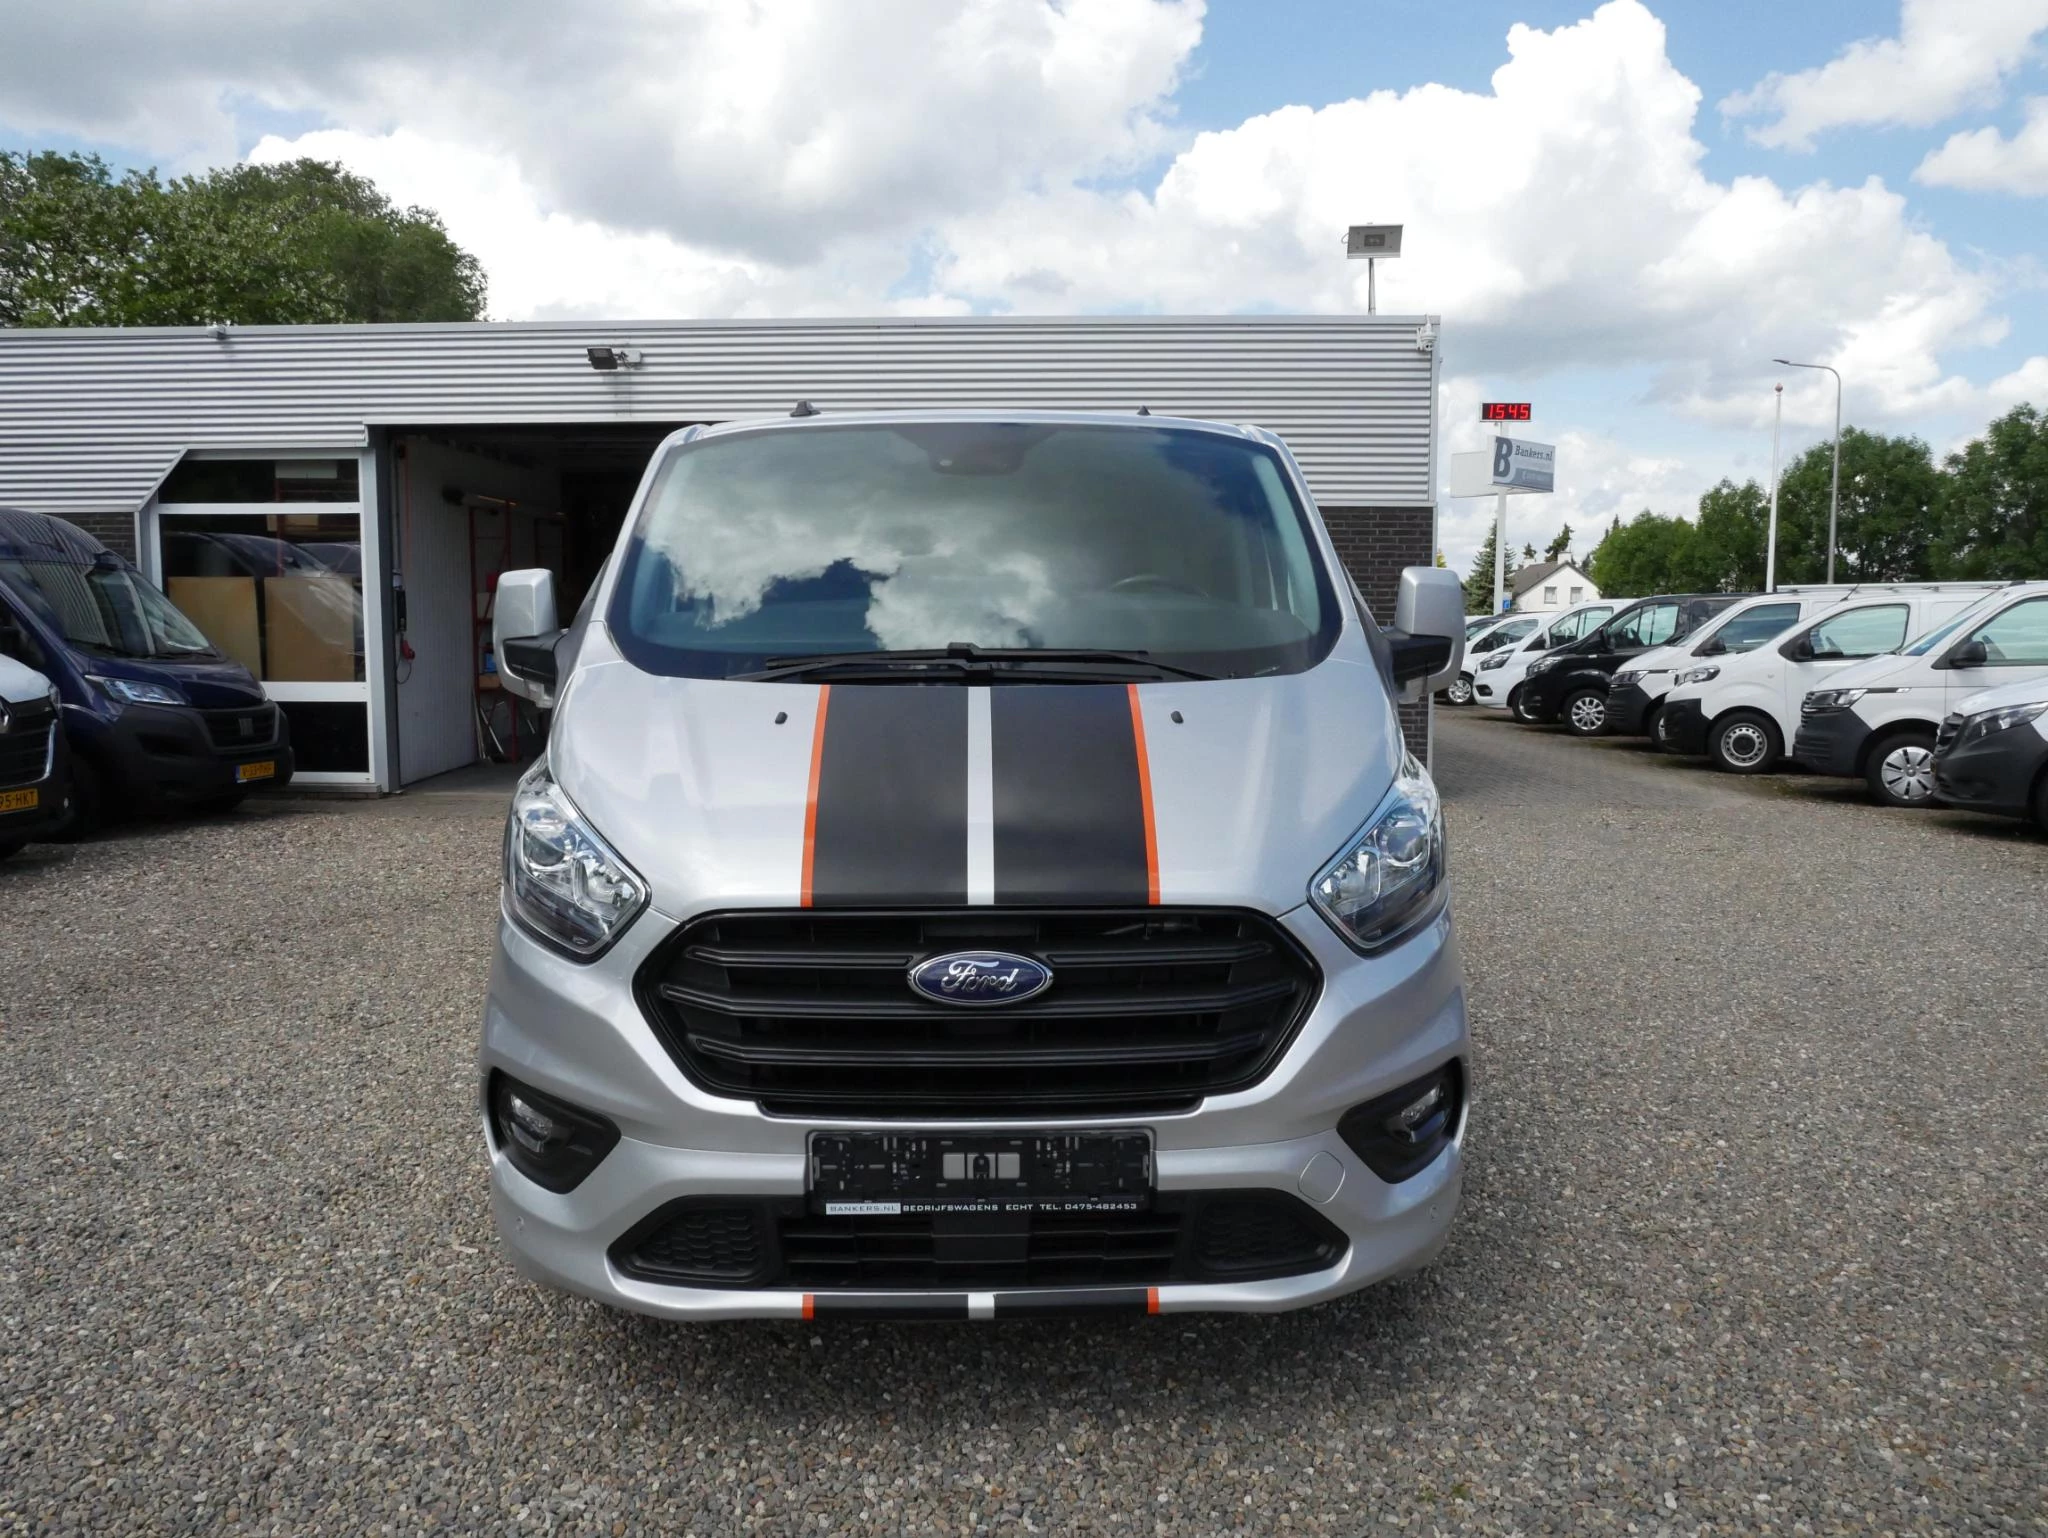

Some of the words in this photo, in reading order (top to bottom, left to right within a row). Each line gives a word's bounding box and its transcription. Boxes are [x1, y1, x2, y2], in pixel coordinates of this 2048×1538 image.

[1493, 436, 1513, 478] B
[1515, 445, 1553, 461] Bankers.nl
[941, 960, 1018, 992] Ford
[829, 1204, 898, 1213] BANKERS.NL
[902, 1204, 998, 1212] BEDRIJFSWAGENS
[1005, 1203, 1034, 1211] ECHT
[1040, 1203, 1062, 1211] TEL.
